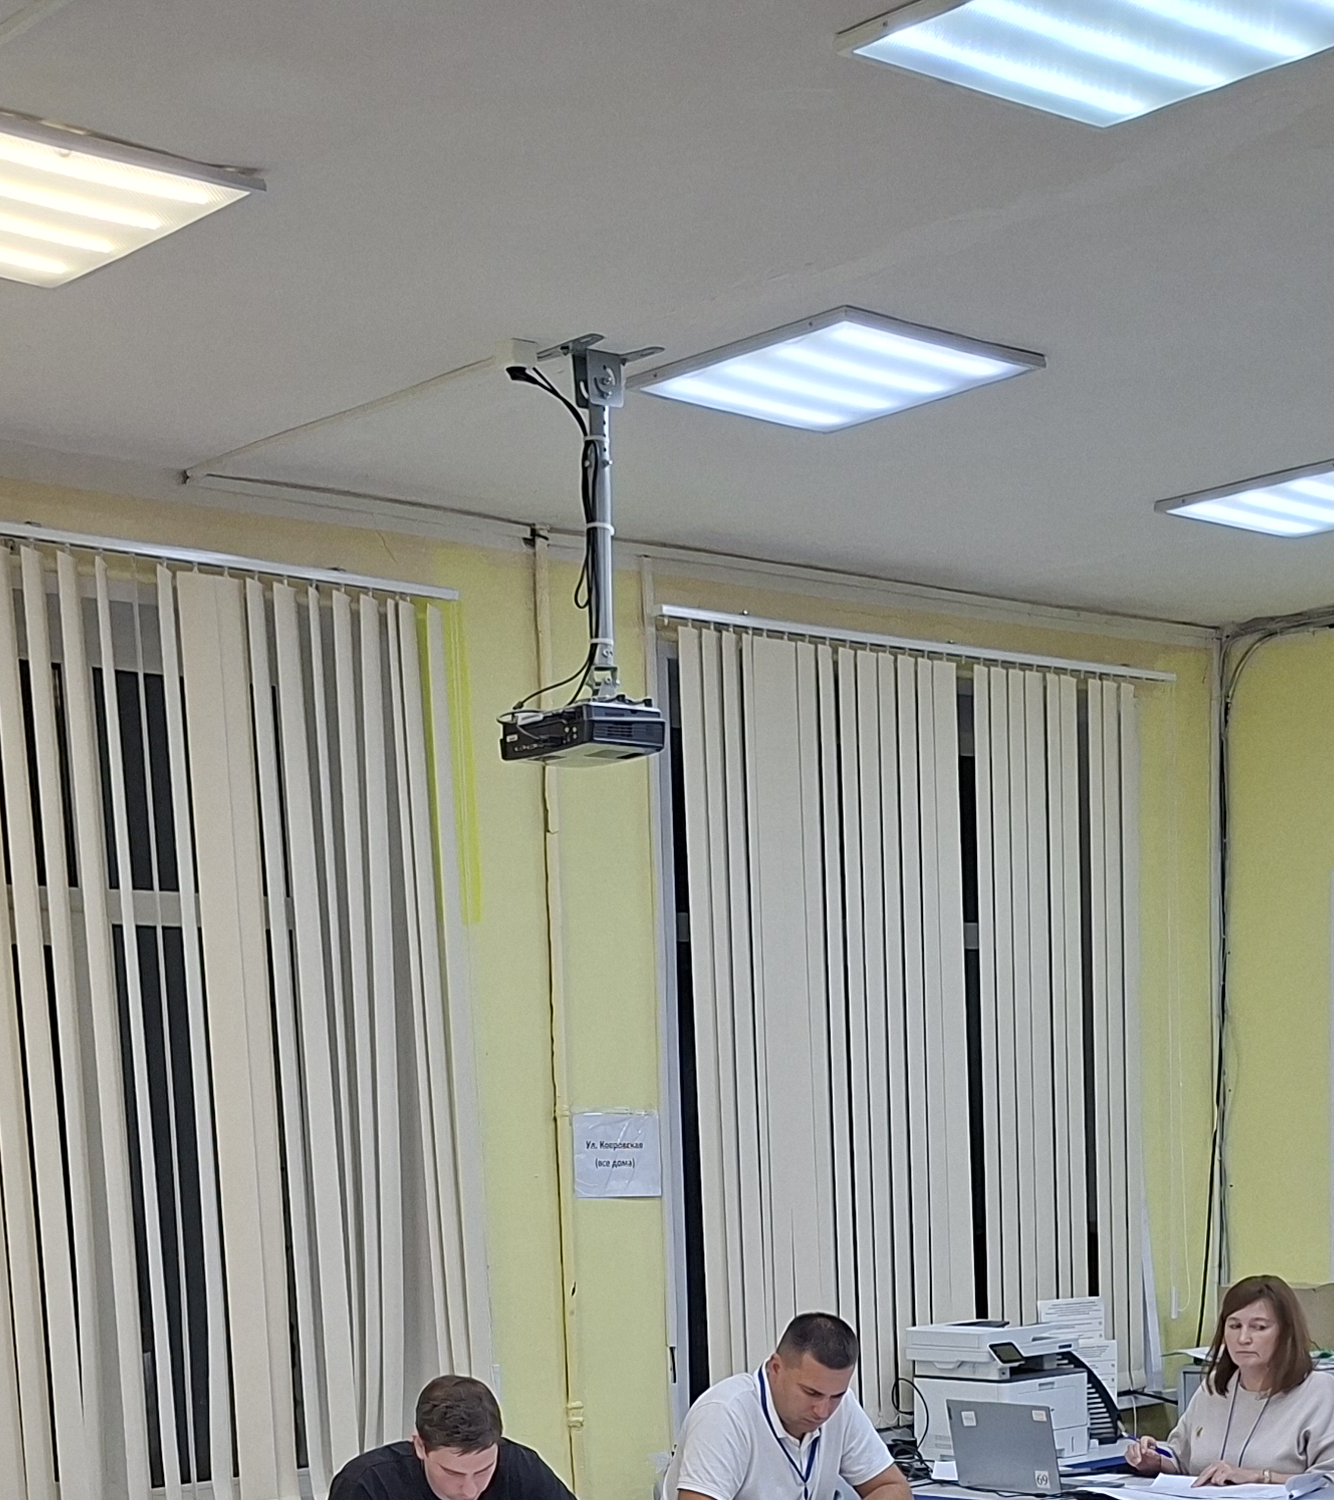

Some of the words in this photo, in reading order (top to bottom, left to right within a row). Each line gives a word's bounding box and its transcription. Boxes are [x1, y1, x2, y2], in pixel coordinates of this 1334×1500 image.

[585, 1141, 598, 1149] Ул.
[599, 1141, 644, 1151] Ковровская
[595, 1157, 611, 1169] (все
[611, 1158, 636, 1169] дома)
[1036, 1473, 1048, 1486] 69
